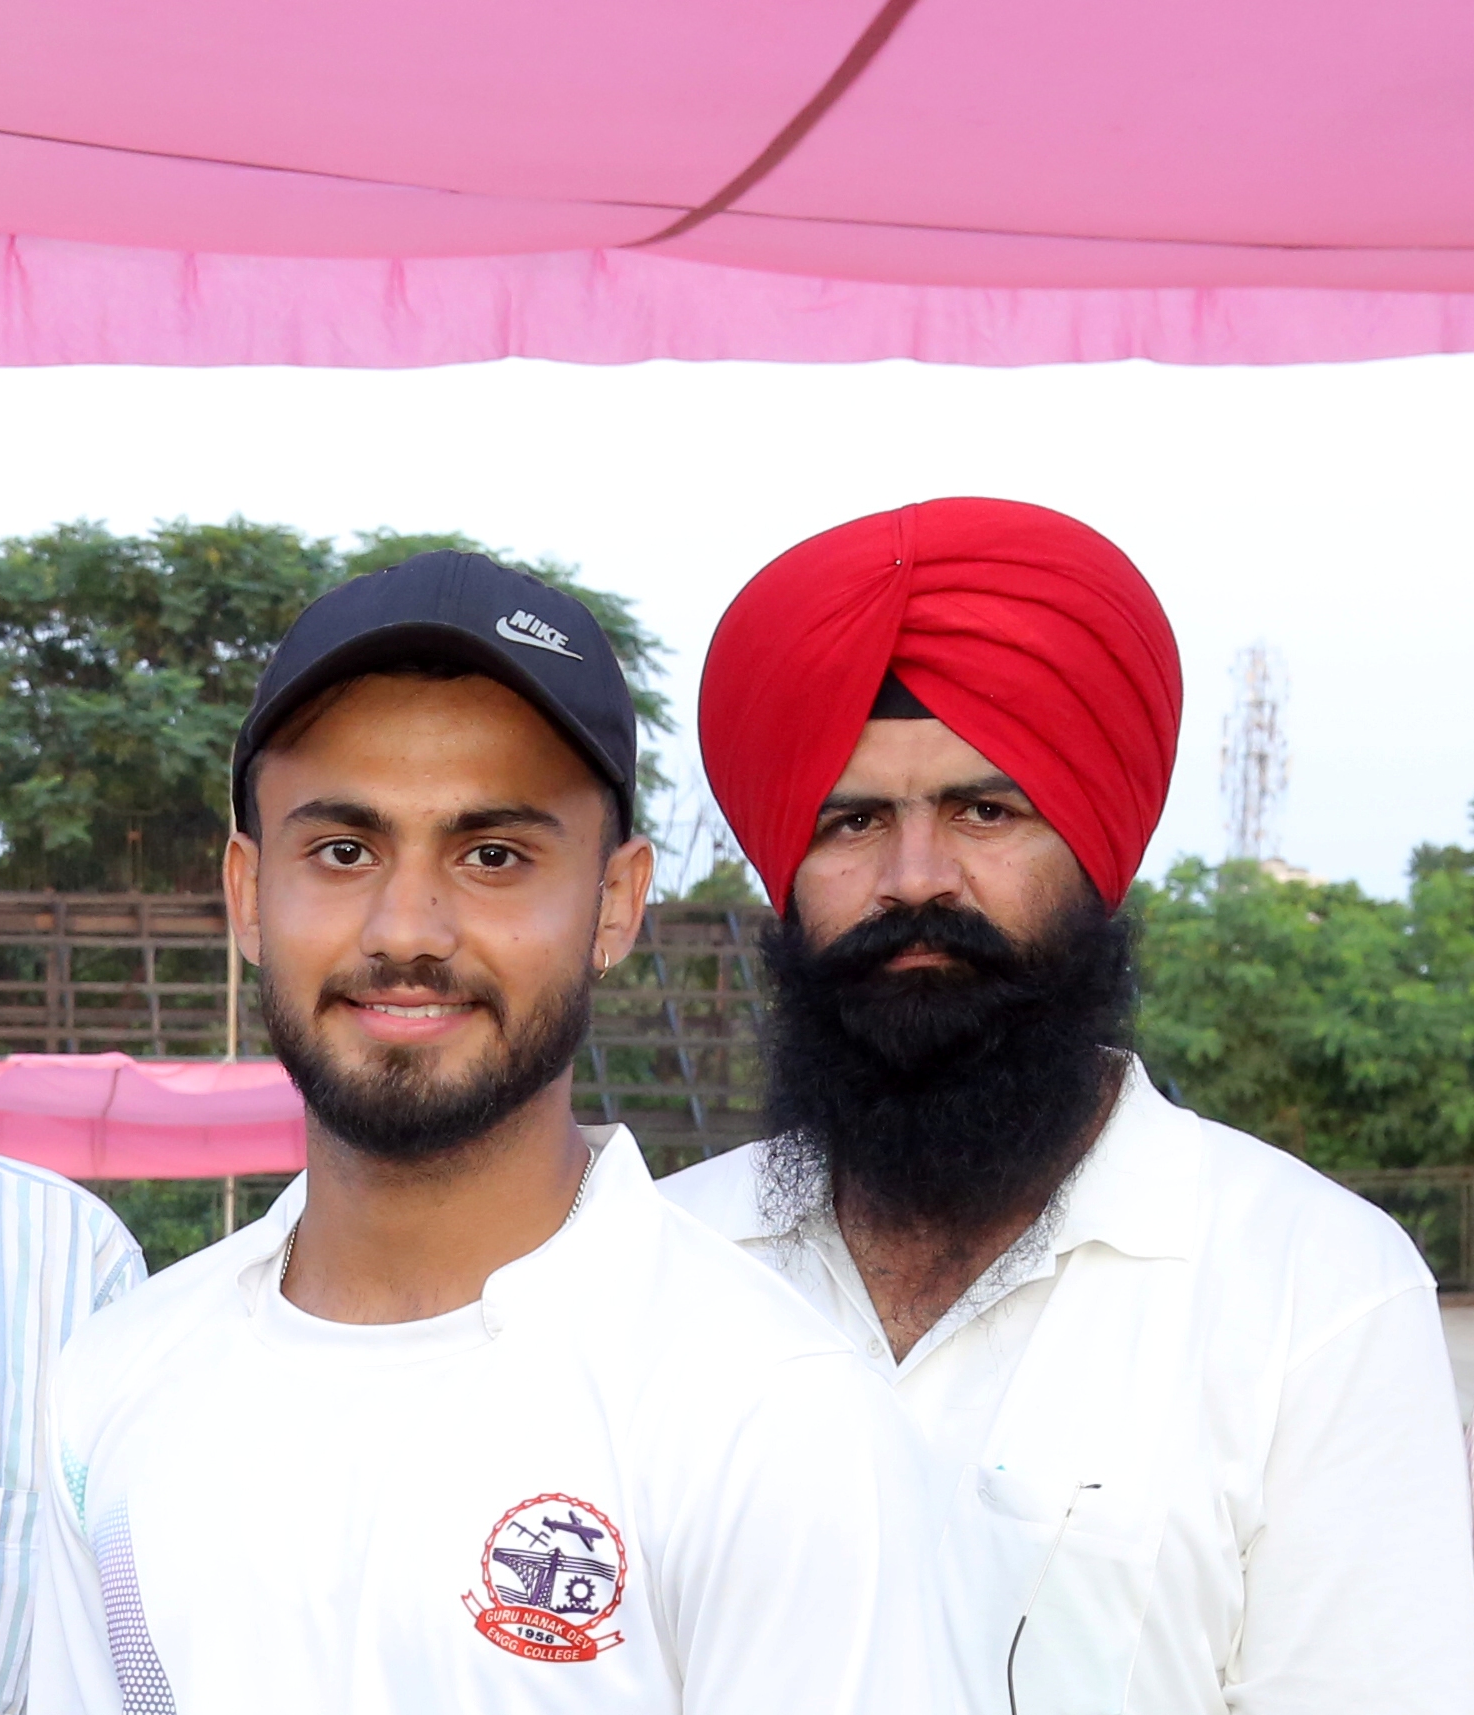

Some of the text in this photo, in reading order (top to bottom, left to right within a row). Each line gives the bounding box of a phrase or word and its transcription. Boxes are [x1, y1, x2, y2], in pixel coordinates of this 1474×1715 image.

[509, 609, 570, 648] NIKE
[485, 1609, 592, 1649] GURU NANAK DEV
[517, 1626, 555, 1644] 1956
[523, 1645, 580, 1660] COLLEGE
